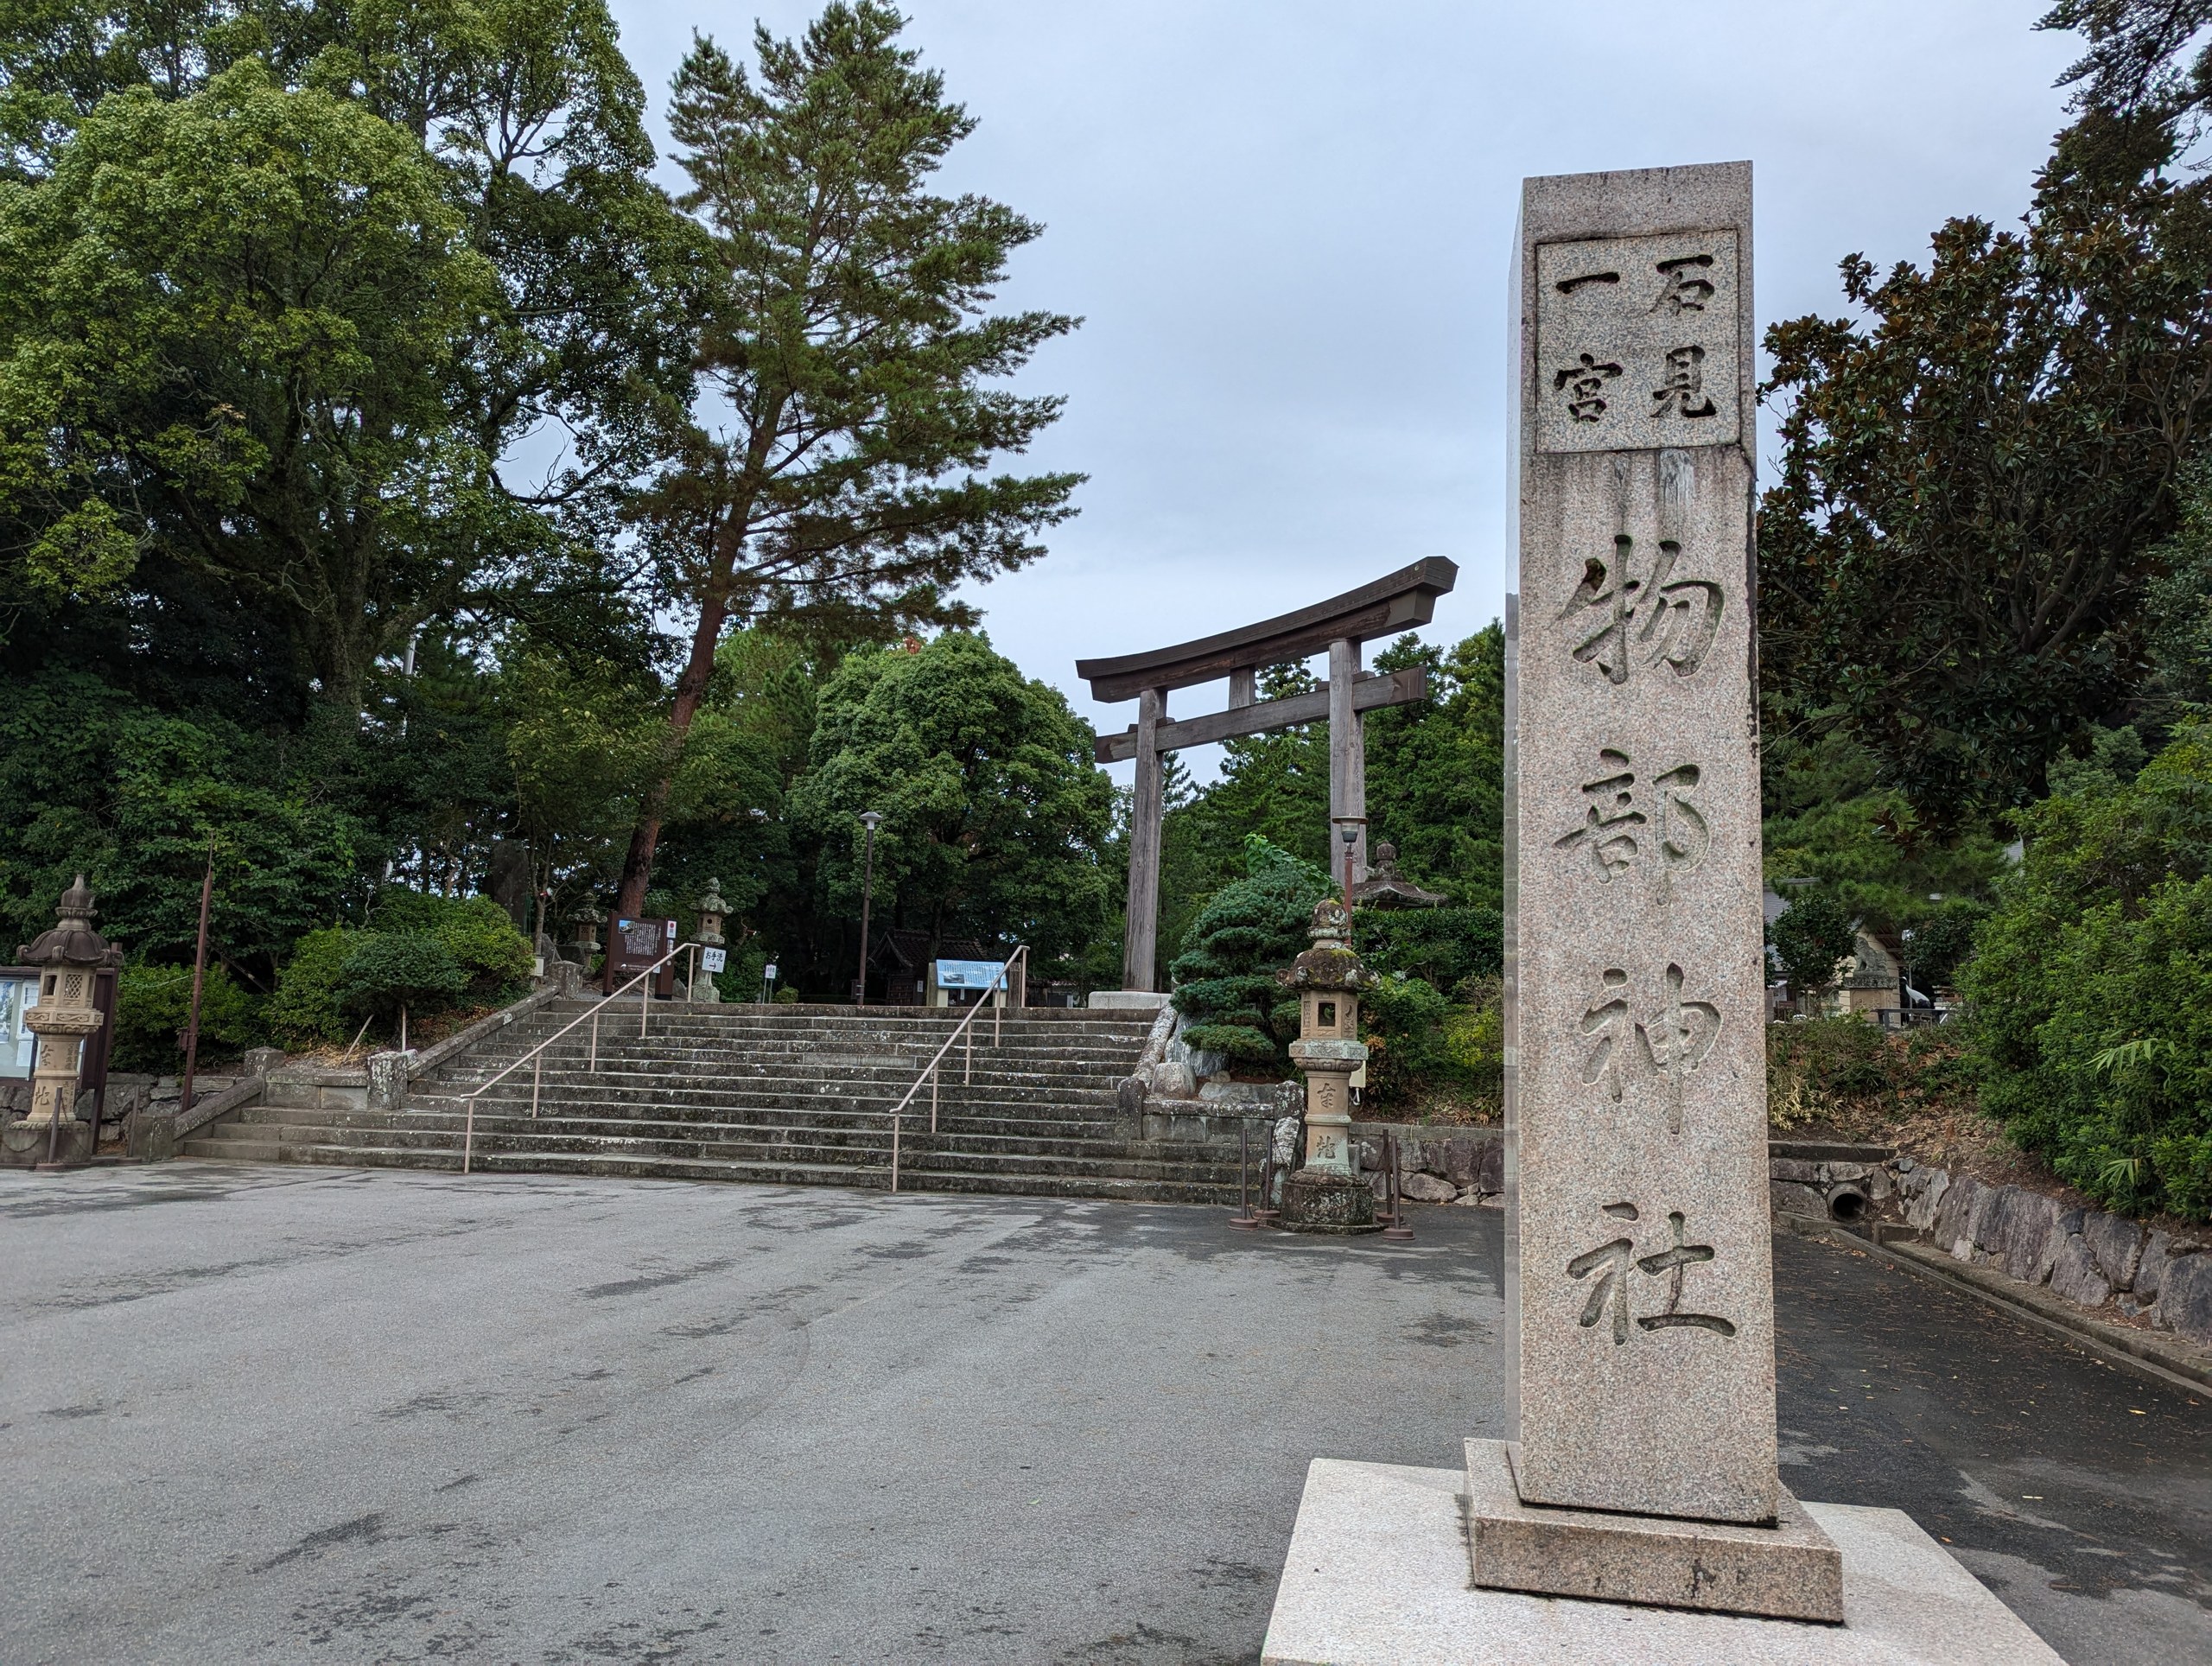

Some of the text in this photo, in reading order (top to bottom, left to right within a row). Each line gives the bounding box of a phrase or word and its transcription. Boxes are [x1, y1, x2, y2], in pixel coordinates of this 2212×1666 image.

[1554, 271, 1624, 423] 一宮
[1649, 254, 1717, 418] 石見
[705, 950, 724, 963] お手洗
[1554, 534, 1737, 1346] 物部神社
